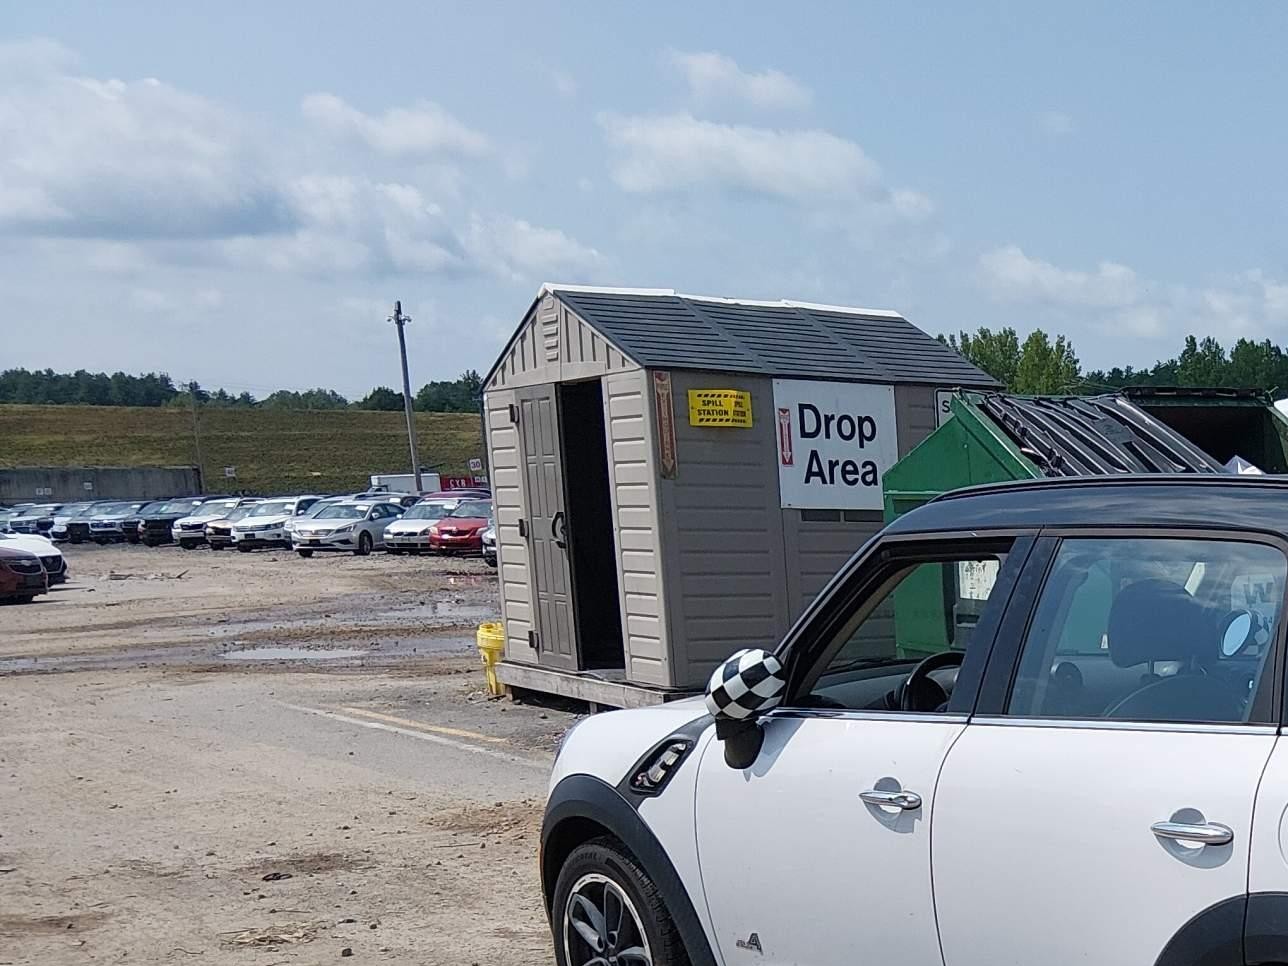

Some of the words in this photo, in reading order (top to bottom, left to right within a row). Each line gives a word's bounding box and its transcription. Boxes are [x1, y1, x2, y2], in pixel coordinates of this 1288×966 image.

[798, 403, 877, 448] Drop
[470, 461, 481, 469] 30
[804, 449, 878, 486] Area
